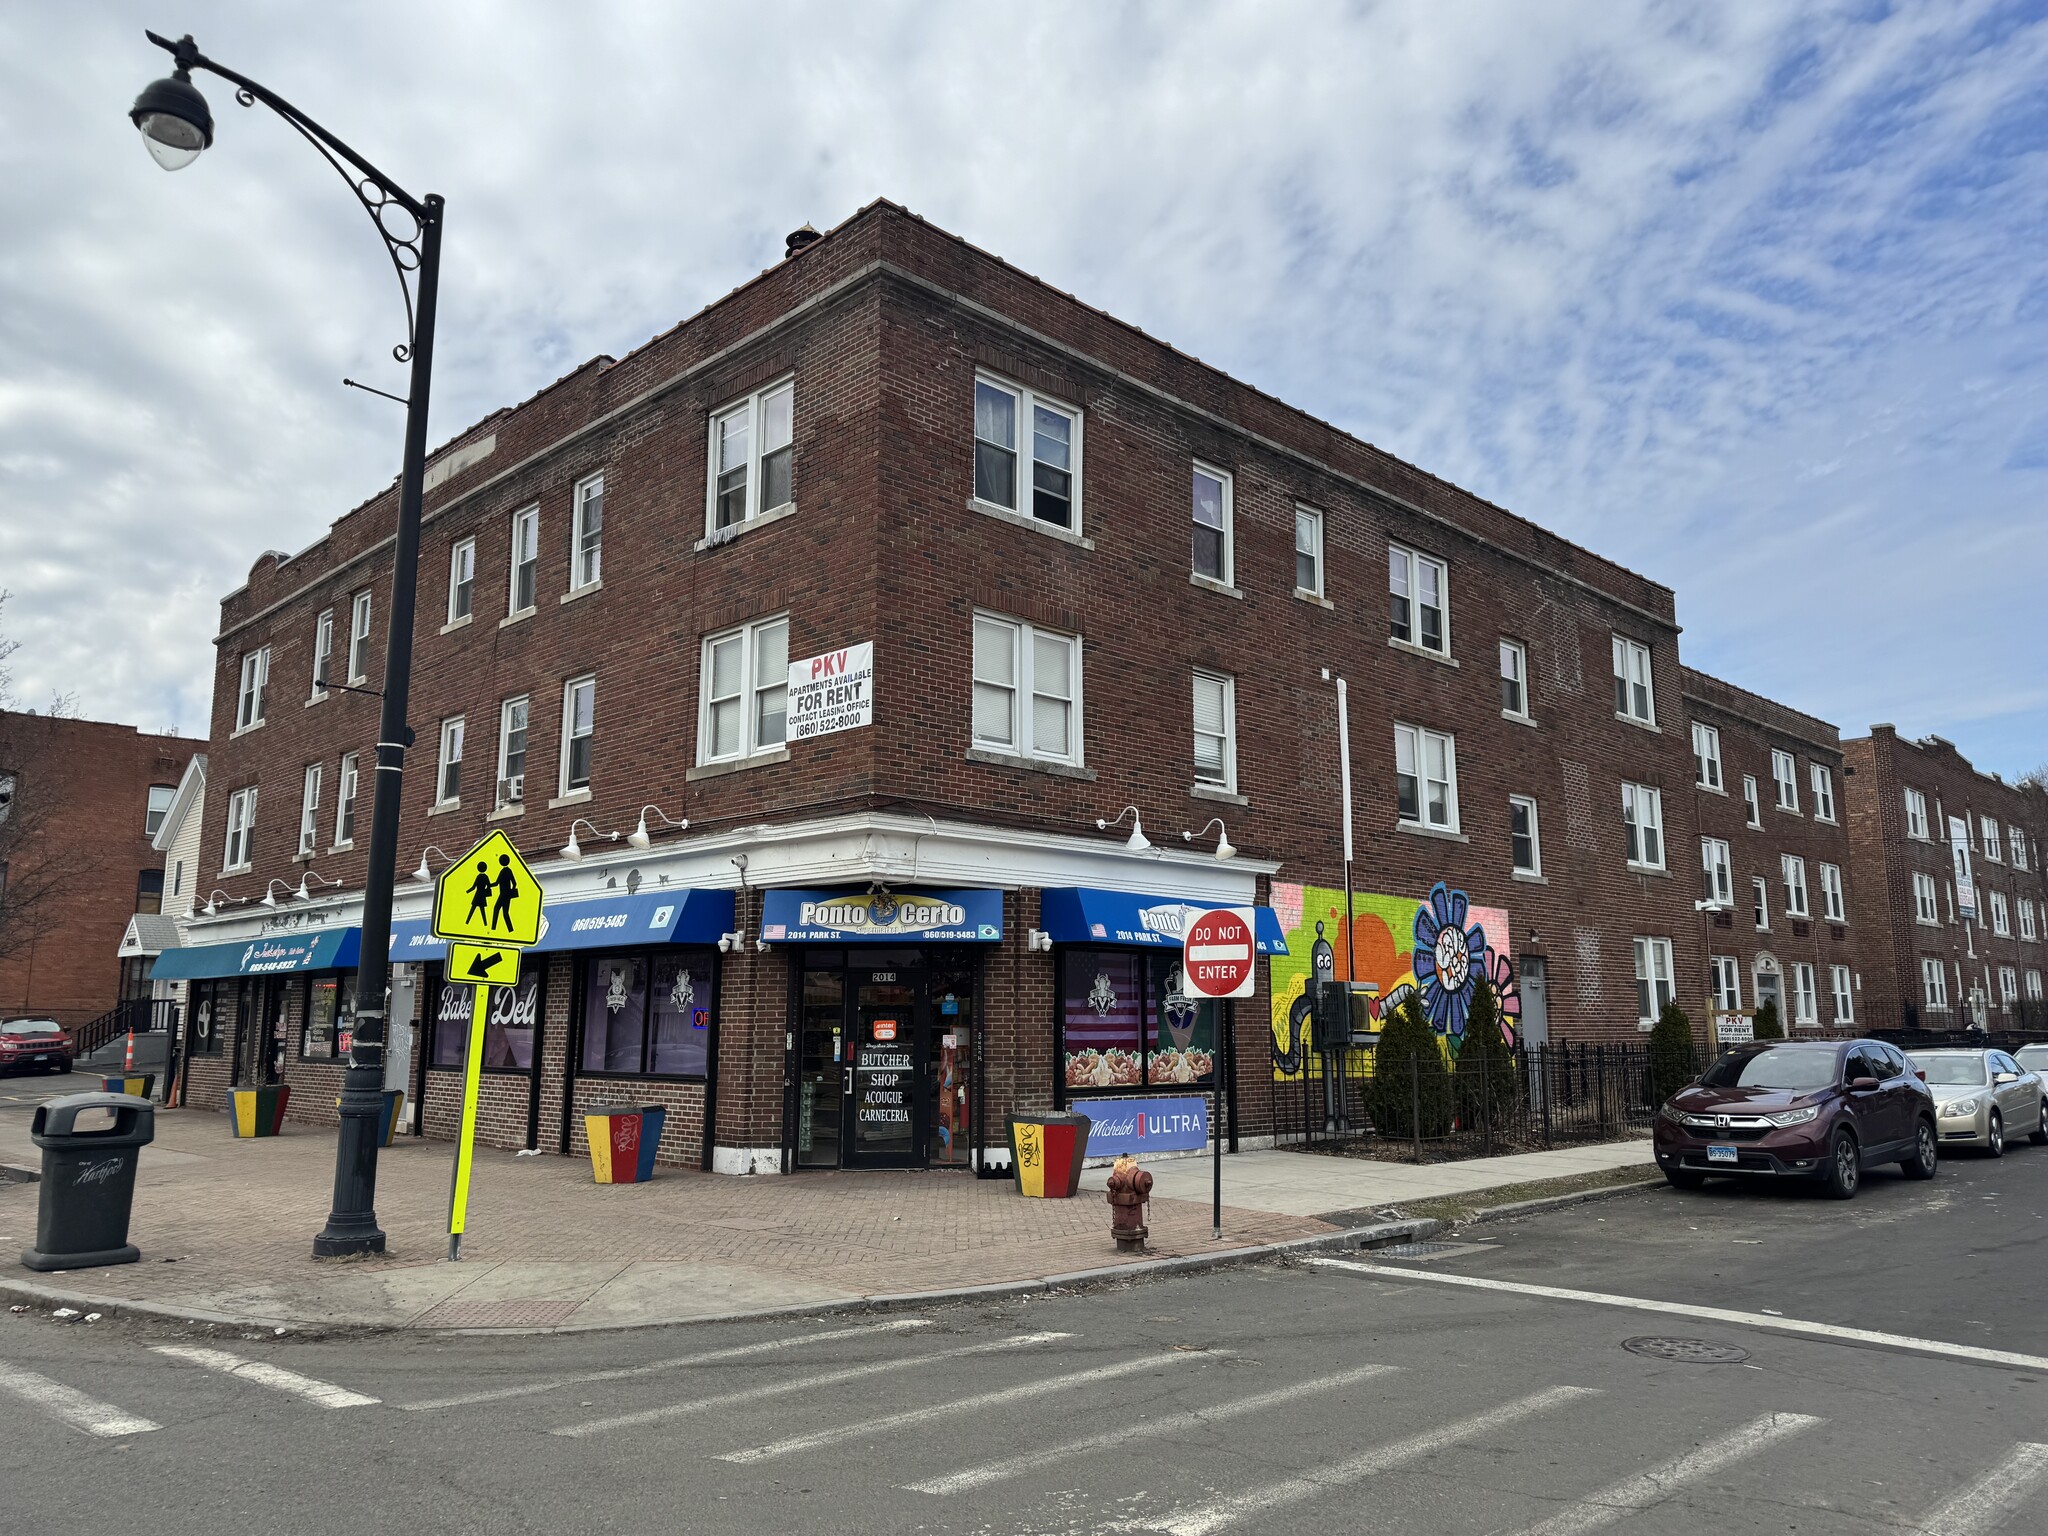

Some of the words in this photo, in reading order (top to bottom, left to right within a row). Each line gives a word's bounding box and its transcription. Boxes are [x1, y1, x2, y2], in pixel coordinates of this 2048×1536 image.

[811, 651, 848, 680] PKV
[789, 678, 833, 697] APARTMENTS
[834, 668, 872, 686] AVAILABLE
[797, 691, 822, 714] FOR
[826, 682, 862, 707] RENT
[788, 711, 817, 725] CONTACT
[819, 705, 845, 718] LEASING
[846, 699, 870, 712] OFFICE
[796, 721, 818, 738] (860)
[800, 902, 866, 925] Ponto
[900, 902, 965, 925] Certo
[1138, 909, 1181, 931] Ponto
[787, 931, 806, 939] 2014
[809, 931, 830, 939] PARK
[830, 931, 841, 939] ST.
[922, 931, 976, 939] (860)519-5483
[1115, 930, 1133, 940] 2014
[1134, 932, 1152, 942] PARK
[1195, 927, 1211, 941] DO
[1218, 926, 1242, 940] NOT
[873, 973, 896, 981] 2014
[1198, 965, 1237, 979] ENTER
[861, 1053, 910, 1067] BUTCHER
[870, 1073, 899, 1087] SHOP
[864, 1091, 903, 1106] AÇOUGUE
[859, 1108, 909, 1122] CARNECERIA
[1089, 1118, 1135, 1137] Michelob
[1149, 1114, 1201, 1134] ULTRA
[72, 1158, 124, 1186] Hartford
